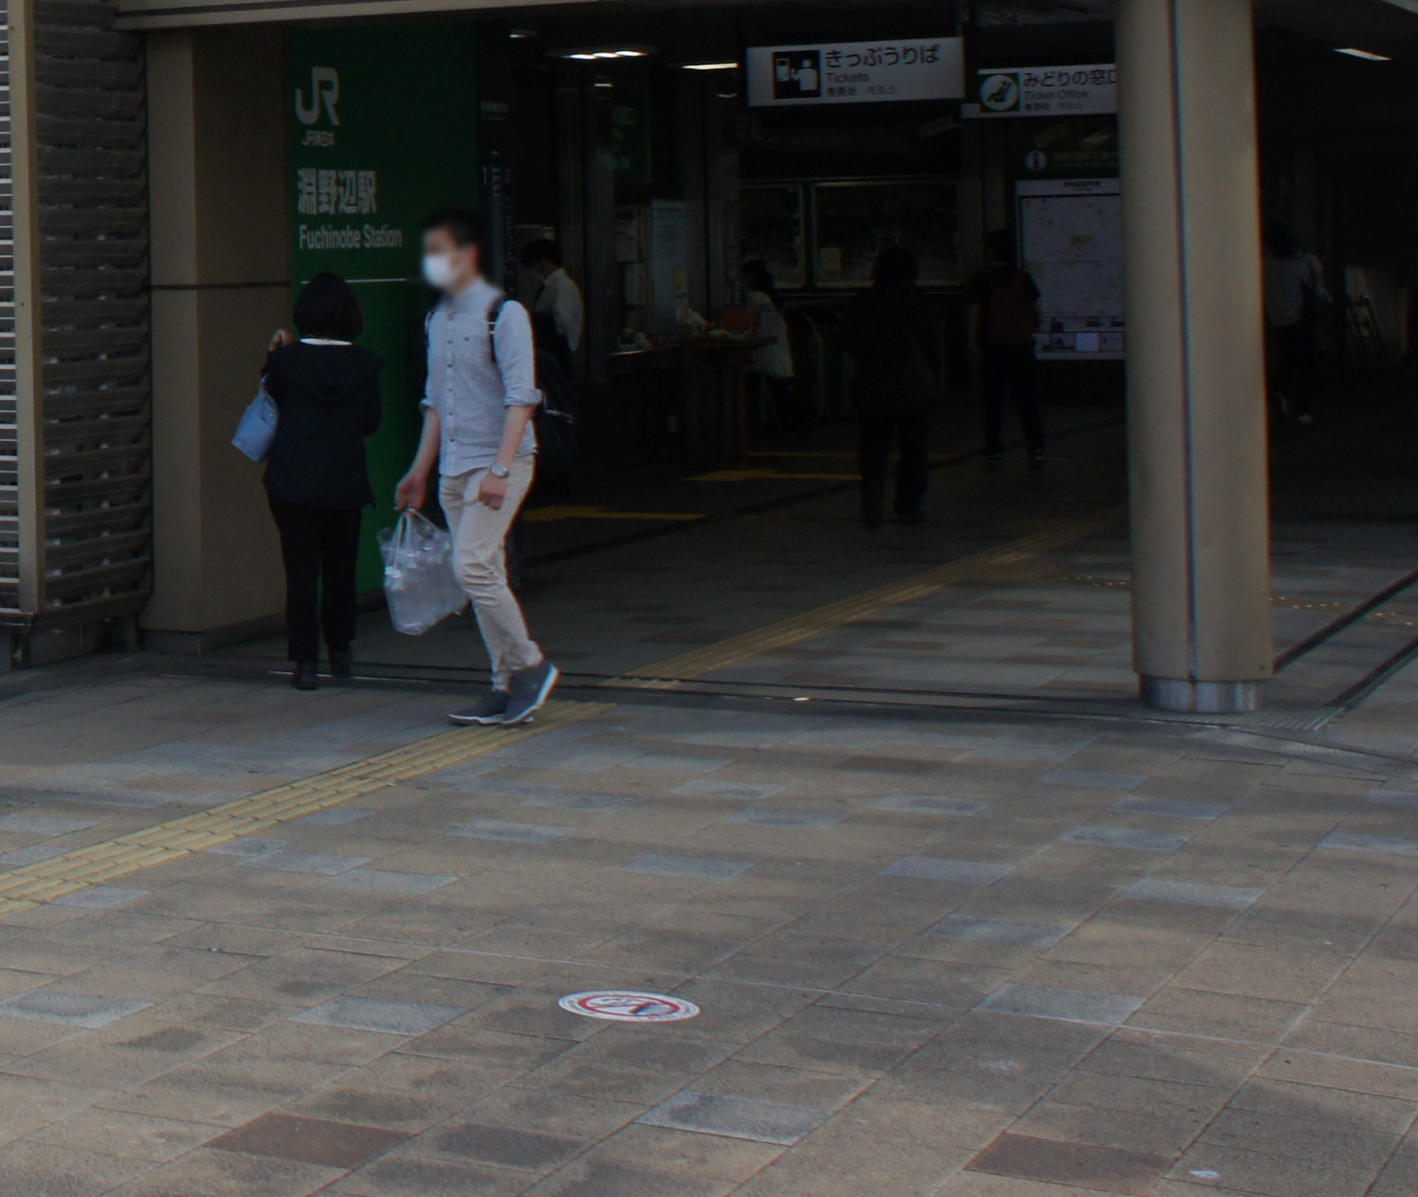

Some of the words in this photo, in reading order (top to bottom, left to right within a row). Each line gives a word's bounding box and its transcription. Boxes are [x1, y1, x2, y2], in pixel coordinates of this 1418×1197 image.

[823, 44, 940, 69] きっぷうりば
[825, 71, 870, 84] Tickets
[1022, 68, 1118, 88] みどりの窓口
[295, 66, 342, 127] JR
[1023, 90, 1055, 100] Ticket
[1058, 88, 1089, 100] Office
[296, 167, 378, 216] 淵野辺駅
[299, 224, 362, 250] Fuchinobe
[362, 223, 403, 249] Station
